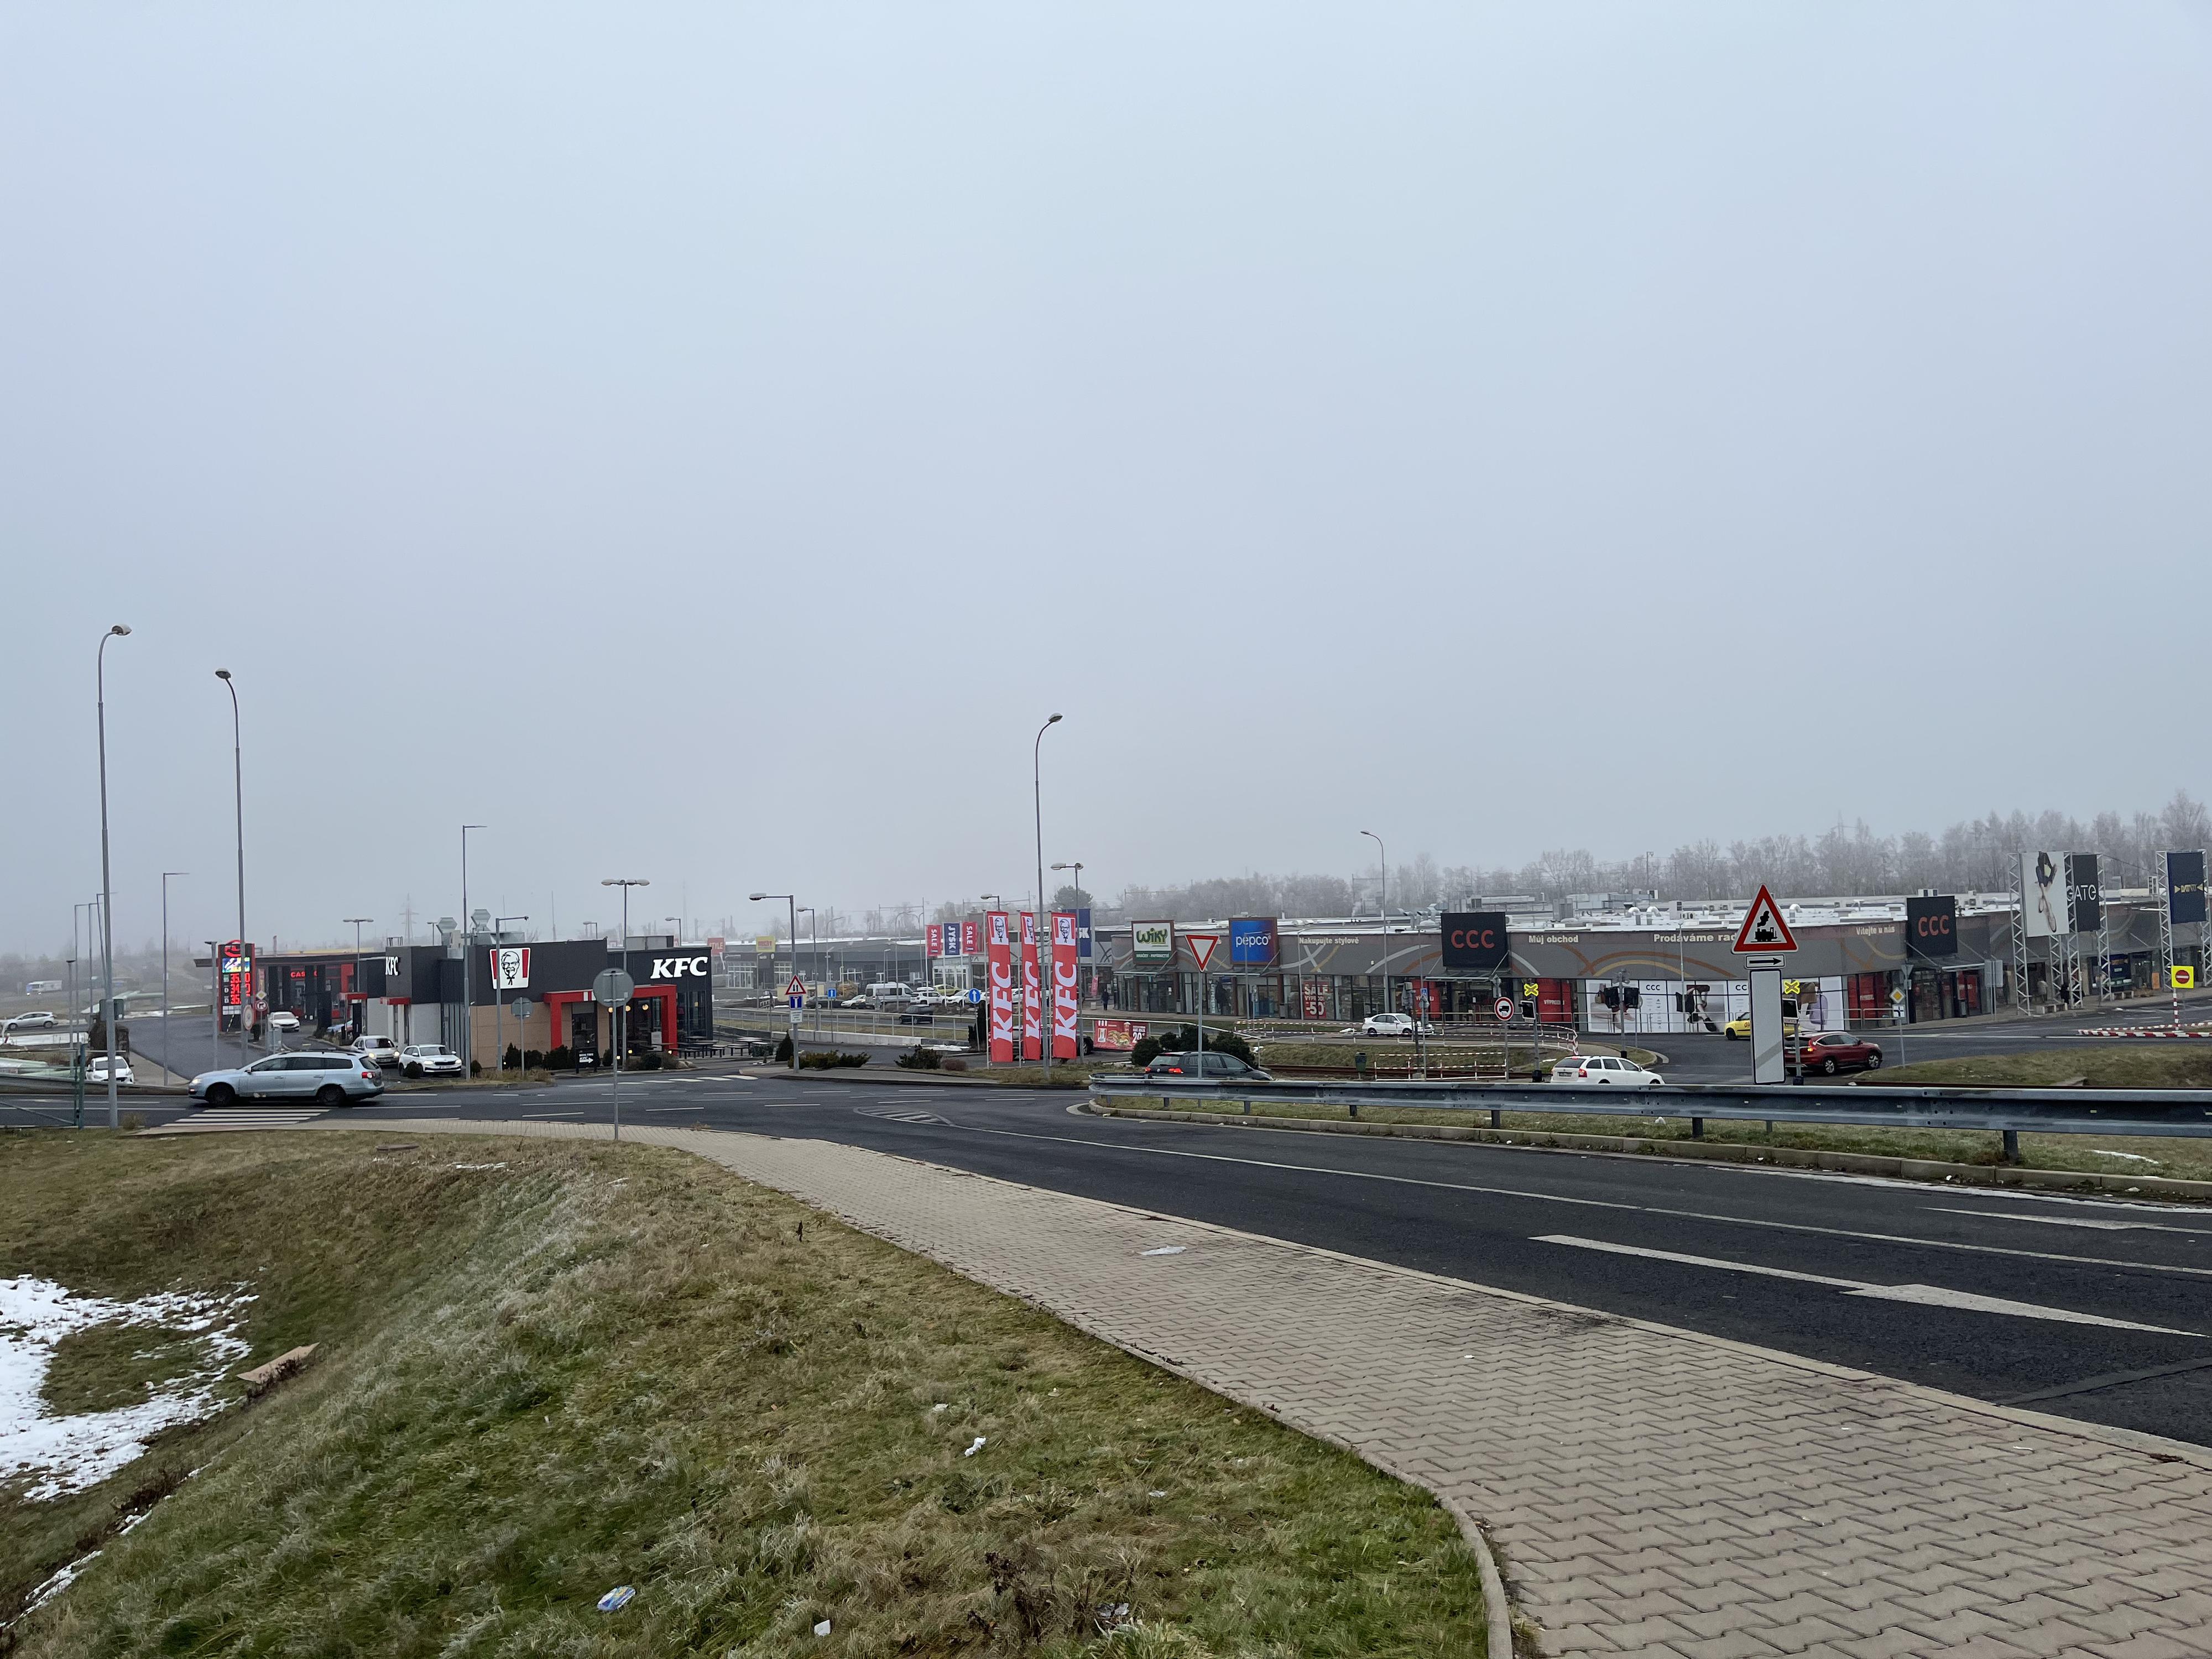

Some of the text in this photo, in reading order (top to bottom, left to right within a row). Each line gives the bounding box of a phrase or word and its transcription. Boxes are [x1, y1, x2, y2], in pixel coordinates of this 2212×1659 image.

[2067, 884, 2096, 901] GATE
[1078, 927, 1090, 938] SK
[1884, 925, 1895, 933] nás
[1918, 915, 1949, 937] CCC
[948, 926, 956, 950] JYSK
[1299, 937, 1359, 945] Nakupujte stylově
[1451, 930, 1495, 948] CCC
[1528, 935, 1579, 945] Můj obchod
[1653, 932, 1735, 942] Prodáváme rad
[385, 956, 399, 976] KFC
[650, 956, 708, 979] KFC
[1304, 984, 1328, 995] SALE
[991, 961, 1013, 1043] KFC
[1025, 961, 1040, 1040] KFC
[1055, 961, 1077, 1042] KFC
